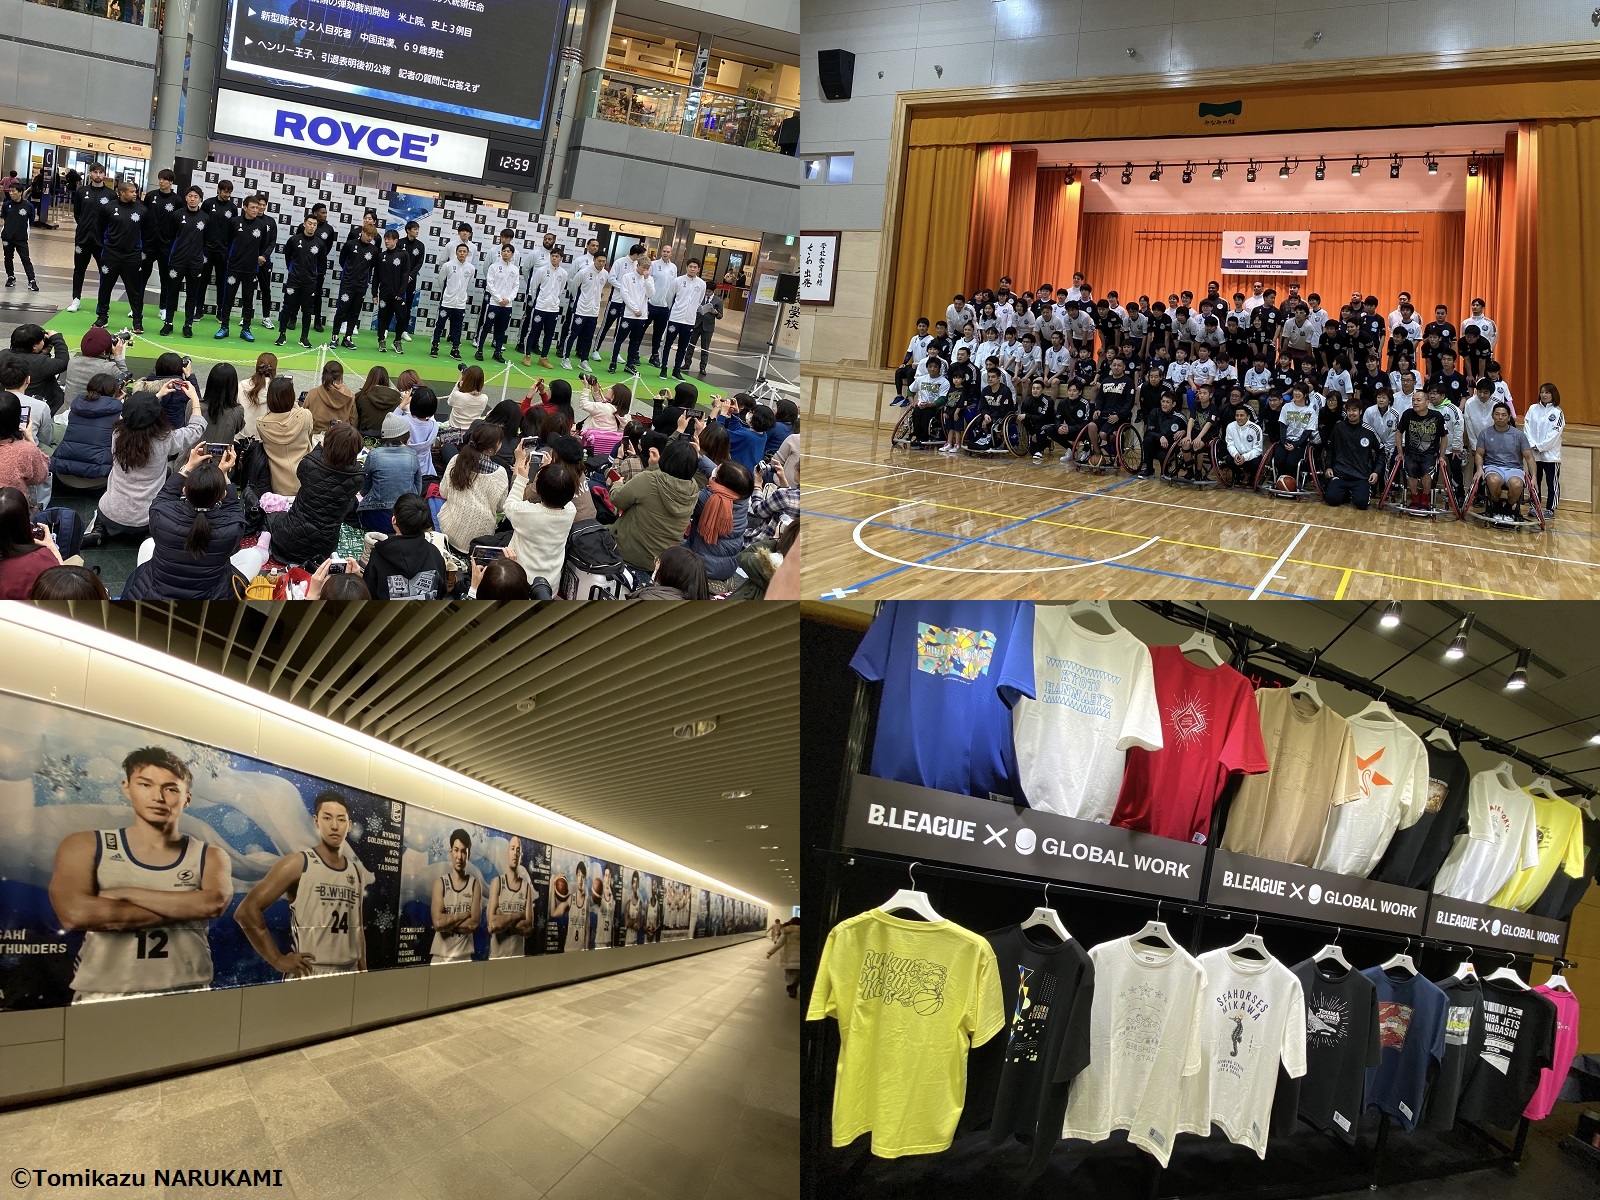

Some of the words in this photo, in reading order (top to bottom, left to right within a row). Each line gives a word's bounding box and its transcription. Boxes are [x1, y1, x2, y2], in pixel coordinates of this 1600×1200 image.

[498, 156, 530, 172] 12:59
[867, 803, 977, 842] B.LEAGUE
[1041, 837, 1129, 869] GLOBAL
[1133, 854, 1192, 879] WORK
[1222, 870, 1287, 897] B.LEAGUE
[1324, 890, 1378, 911] GLOBAL
[1380, 900, 1418, 919] WORK
[331, 910, 348, 934] 24
[1435, 910, 1479, 931] B.LEAGUE
[1501, 924, 1535, 941] GLOBAL
[1536, 930, 1560, 945] WORK
[135, 929, 169, 960] 12
[1216, 988, 1269, 1013] SEAHORSES
[1221, 1000, 1262, 1021] MIKAWA
[1500, 1017, 1521, 1030] JETS
